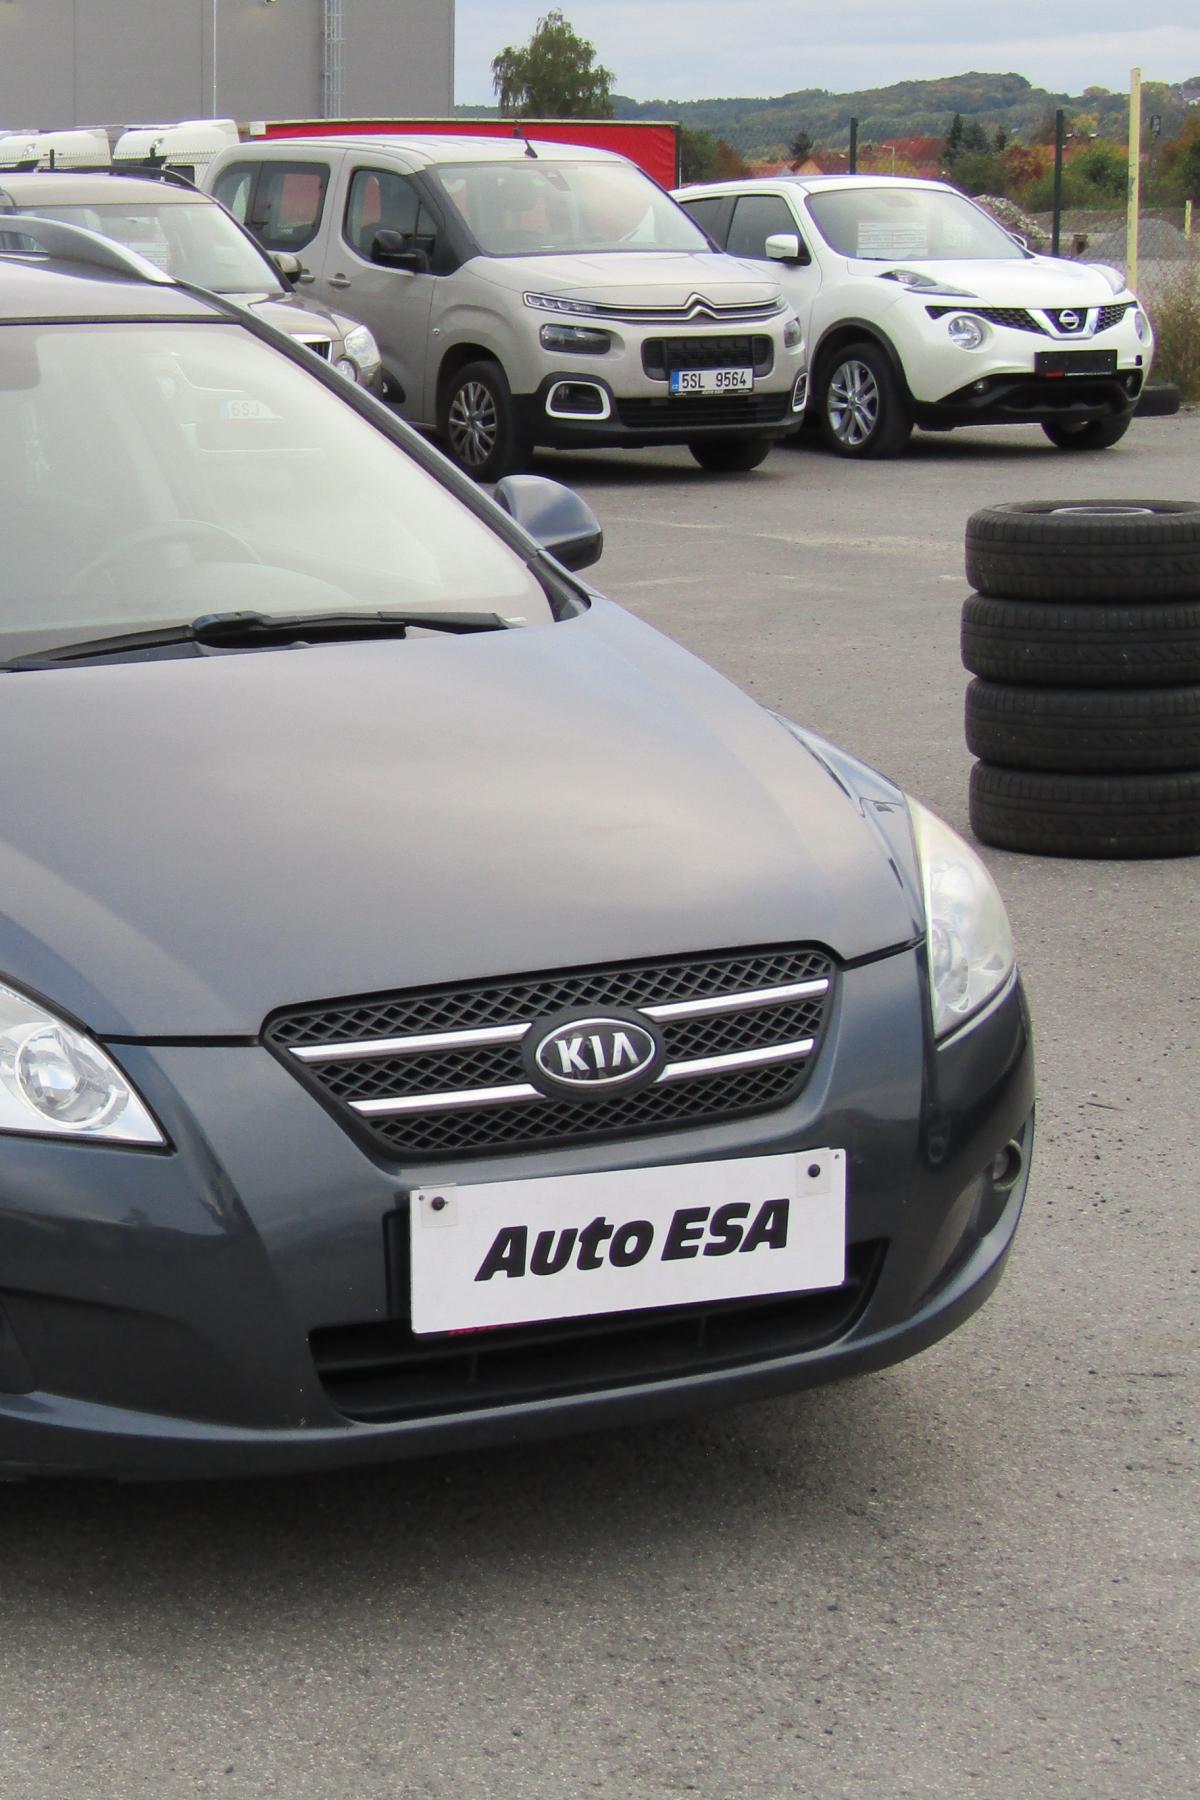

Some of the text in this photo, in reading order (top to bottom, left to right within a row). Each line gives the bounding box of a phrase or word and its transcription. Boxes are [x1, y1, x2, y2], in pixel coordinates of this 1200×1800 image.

[682, 371, 746, 389] 5SL 9564
[554, 1032, 639, 1075] KIA
[473, 1198, 790, 1281] Auto ESA
